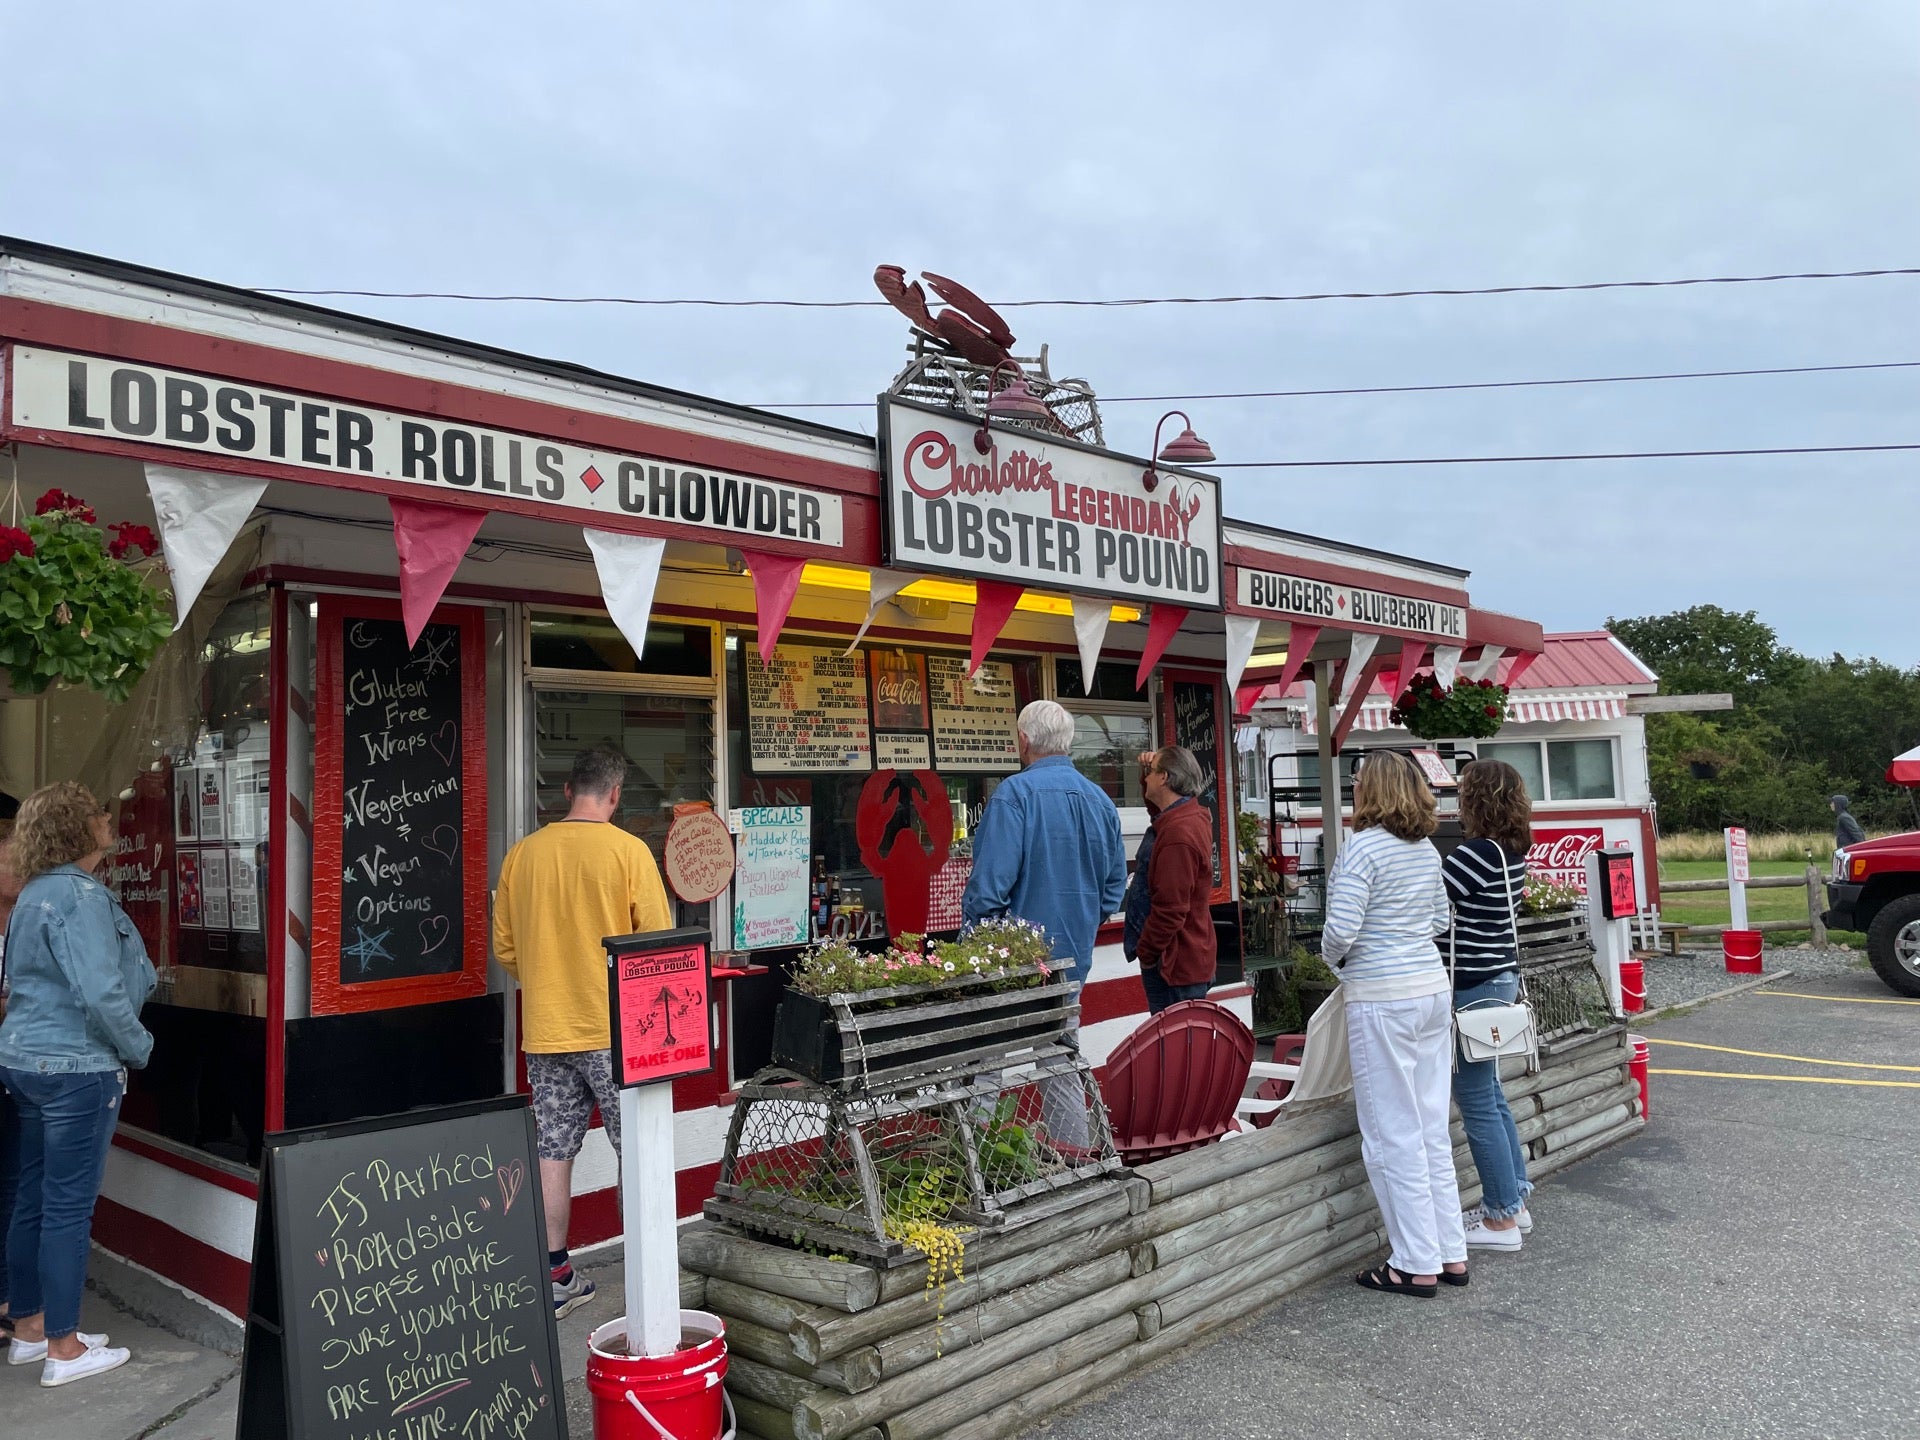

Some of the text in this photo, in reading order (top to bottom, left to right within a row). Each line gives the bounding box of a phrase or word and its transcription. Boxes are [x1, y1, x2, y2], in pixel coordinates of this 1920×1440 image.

[68, 360, 821, 541] LOBSTER ROLLS CHOWDER
[901, 490, 1209, 594] LOBSTER POUND
[1250, 573, 1460, 635] BURGERS BLUEBERRY PIE
[350, 668, 428, 706] Gluten
[878, 676, 921, 705] Coca-Cola
[1175, 685, 1198, 719] World
[385, 701, 431, 730] Free
[1186, 708, 1210, 737] Famous
[360, 730, 428, 766] Wraps
[345, 777, 459, 826] Vegetarian
[750, 831, 787, 846] Haddock
[759, 847, 787, 861] Tartar
[356, 844, 422, 887] Vegan
[741, 871, 767, 886] Bacon
[356, 896, 432, 924] Options
[811, 911, 886, 943] LOVE
[625, 965, 661, 977] LOBSTER
[664, 960, 696, 971] POUND
[627, 1044, 706, 1069] TAKE ONE
[316, 1172, 368, 1237] If
[386, 1332, 468, 1401] behind
